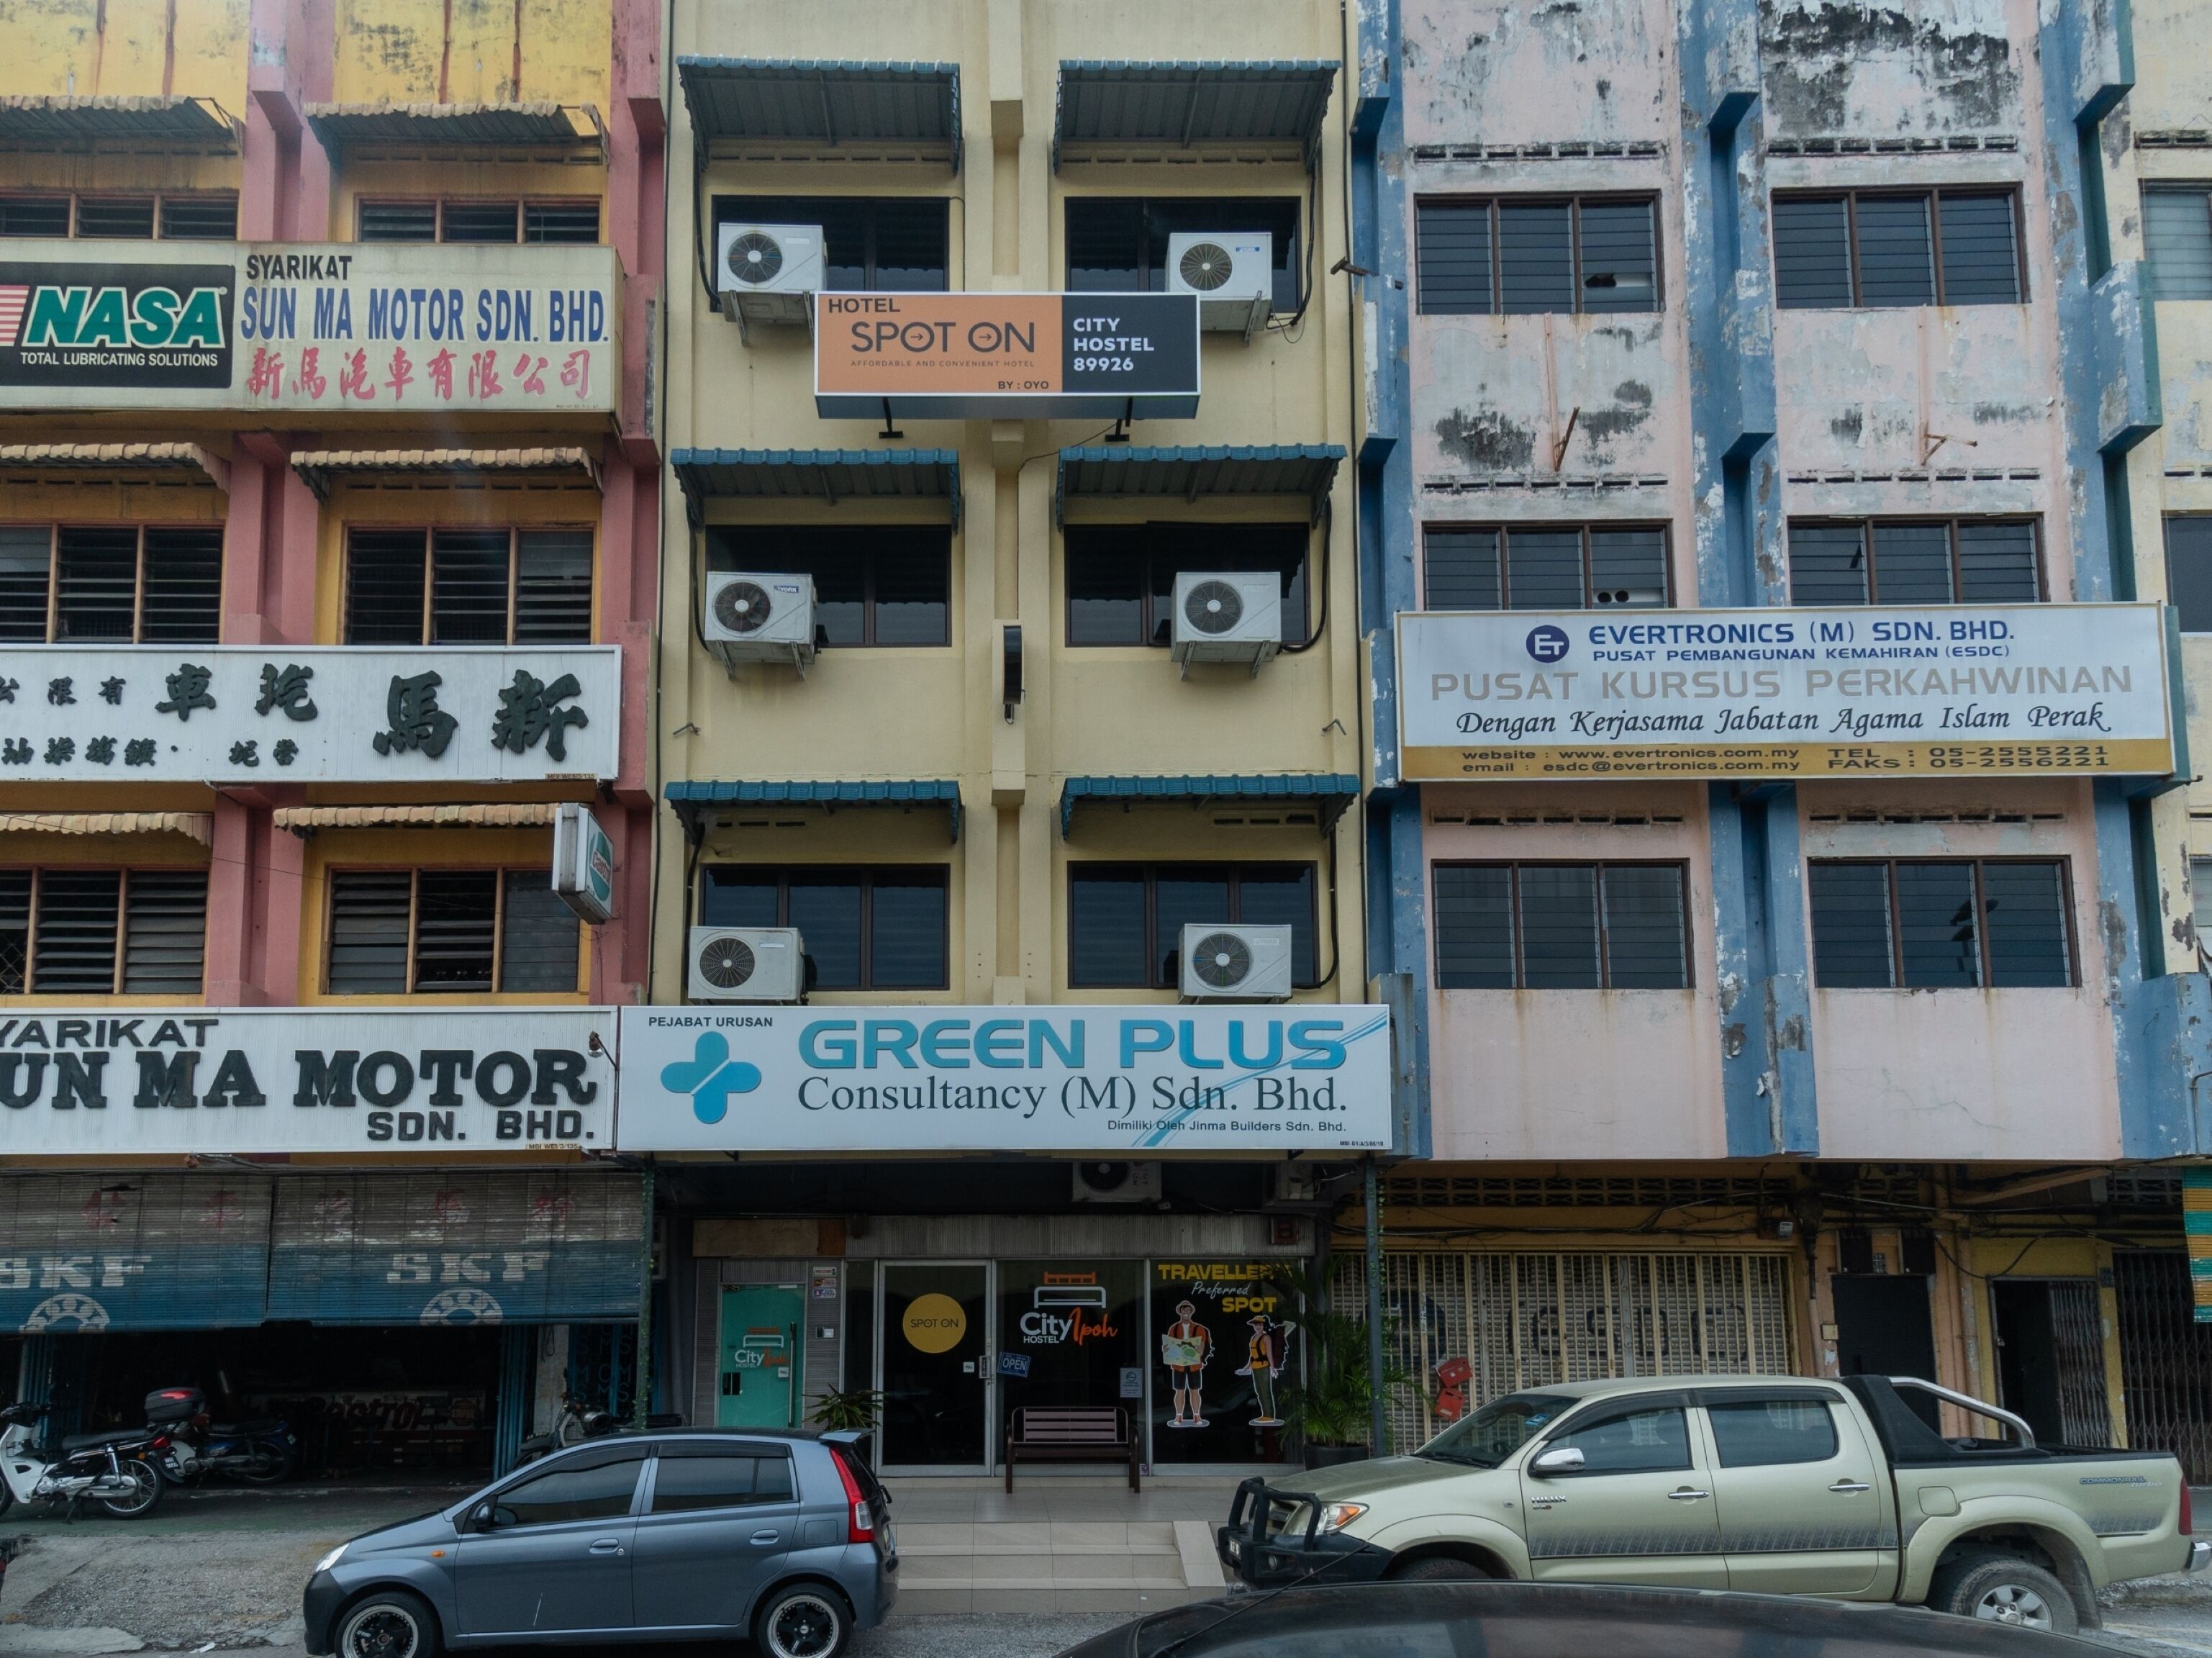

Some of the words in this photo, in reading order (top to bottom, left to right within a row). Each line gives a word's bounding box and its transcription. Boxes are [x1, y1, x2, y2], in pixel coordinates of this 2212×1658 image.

[246, 255, 352, 281] SYARIKAT
[241, 286, 296, 340] SUN
[314, 288, 353, 340] MA
[368, 288, 465, 342] MOTOR
[476, 289, 539, 342] SDN.
[549, 290, 609, 343] BHD.
[828, 299, 901, 313] HOTEL
[22, 286, 226, 348] NASA
[1073, 318, 1120, 332] CITY
[851, 322, 956, 353] SPOT
[968, 322, 1035, 353] ON
[1074, 338, 1154, 351] HOSTEL
[20, 352, 59, 365] TOTAL
[63, 353, 145, 366] LUBRICATING
[148, 353, 218, 367] SOLUTIONS
[1074, 358, 1134, 371] 89926
[248, 346, 591, 402] 新馬汽車有限公司
[997, 381, 1014, 389] BY
[1024, 381, 1048, 389] OYO
[1589, 623, 1794, 645] EVERTRONICS
[1809, 621, 1854, 643] (M)
[1872, 622, 1941, 640] SDN.
[1950, 620, 2015, 640] BHD.
[1593, 651, 1656, 661] PUSAT
[1667, 648, 1816, 661] PEMBANGUNAN
[1826, 647, 1938, 658] KEMAHIRAN
[1946, 645, 2010, 658] (ESDC)
[1432, 672, 1579, 701] PUSAT
[1603, 670, 1780, 699] KURSUS
[1807, 666, 2132, 697] PERKAHWINAN
[1456, 712, 1556, 740] Dengan
[1569, 710, 1704, 740] Kerjasama
[1714, 705, 1819, 735] Jabatan
[1828, 707, 1923, 737] Agama
[1939, 704, 2011, 729] Islam
[2027, 702, 2112, 732] Perak
[1462, 750, 1536, 760] website
[1559, 746, 1799, 761] www.evertronics.com.my
[1828, 748, 1880, 758] TEL
[1929, 746, 2108, 756] 05-2555221
[1462, 762, 1514, 772] email
[1543, 760, 1799, 773] esdc@evertronics.com.my
[1828, 760, 1900, 769] FAKS
[1929, 756, 2109, 767] 05-2556221
[648, 1017, 710, 1028] PEJABAT
[716, 1017, 773, 1028] URUSAN
[798, 1019, 1085, 1069] GREEN
[1120, 1019, 1347, 1069] PLUS
[134, 1050, 266, 1108] MA
[293, 1049, 597, 1107] MOTOR
[798, 1077, 1047, 1119] Consultancy
[1061, 1076, 1136, 1119] (M)
[1153, 1076, 1237, 1110] Sdn.
[1254, 1077, 1346, 1111] Bhd.
[367, 1111, 466, 1141] SDN.
[497, 1110, 594, 1139] BHD.
[1107, 1120, 1152, 1131] Dimiliki
[1156, 1120, 1186, 1131] Oleh
[1189, 1120, 1226, 1131] Jinma
[1231, 1120, 1282, 1132] Builders
[1286, 1121, 1315, 1132] Sdn.
[1319, 1121, 1347, 1132] Bhd.
[387, 1252, 550, 1284] SKF
[1191, 1281, 1251, 1300] Preferred
[1222, 1297, 1277, 1313] SPOT
[910, 1319, 938, 1328] SPOT
[940, 1318, 958, 1328] ON
[1020, 1313, 1073, 1340] City
[735, 1349, 764, 1366] City
[1002, 1358, 1026, 1371] OPEN
[2080, 1476, 2146, 1485] COMMONRAIL
